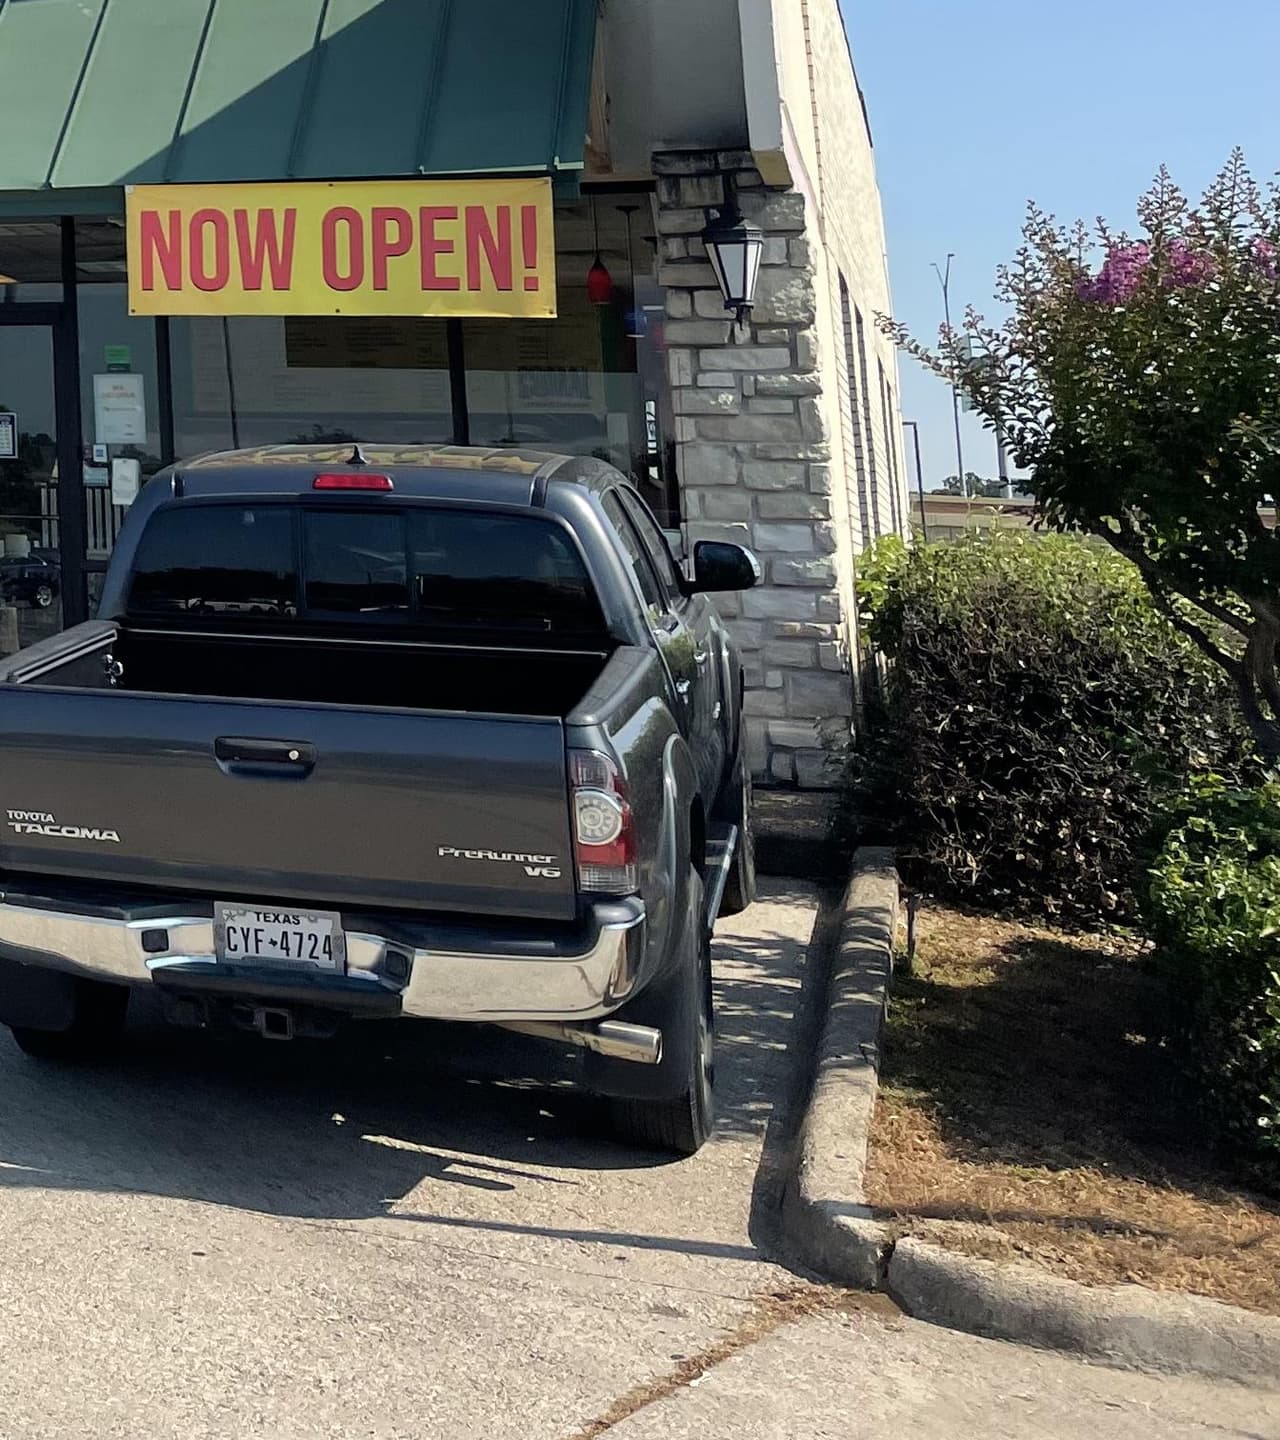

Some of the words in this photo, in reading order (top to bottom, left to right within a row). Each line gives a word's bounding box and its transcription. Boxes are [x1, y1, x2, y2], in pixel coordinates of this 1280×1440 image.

[141, 207, 297, 291] NOW
[321, 205, 540, 291] OPEN!
[6, 810, 55, 823] TOYOTA
[7, 822, 121, 842] TACOMA
[438, 846, 559, 864] PreRunner
[523, 866, 561, 878] V6
[254, 911, 301, 926] TEXAS
